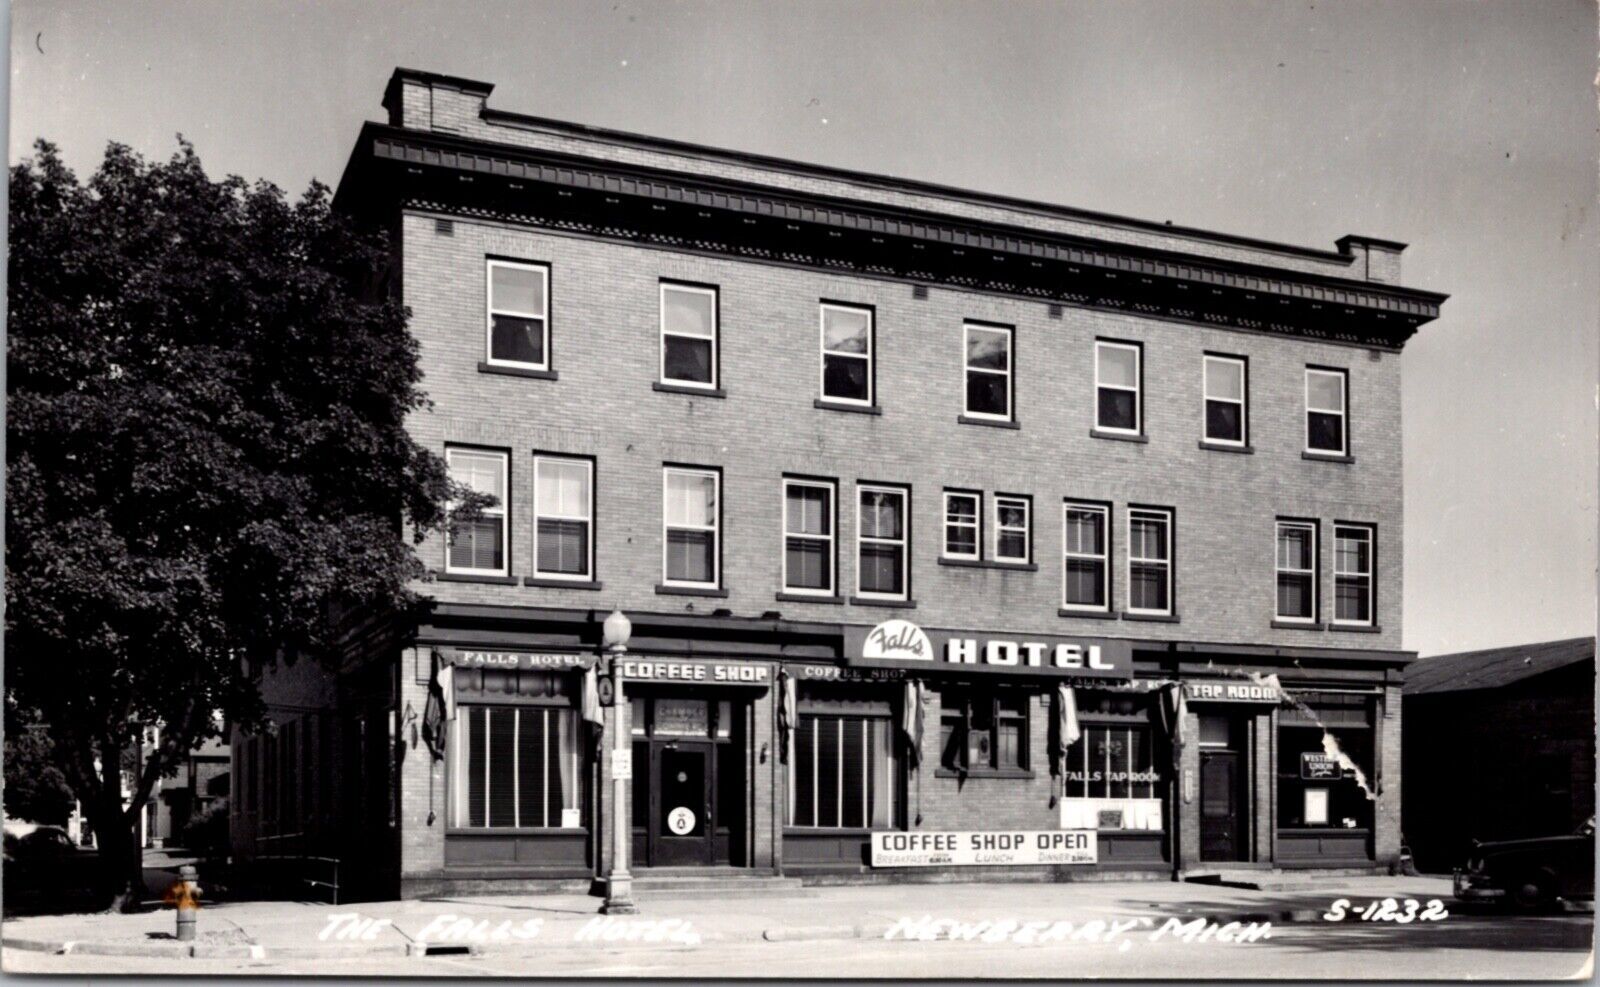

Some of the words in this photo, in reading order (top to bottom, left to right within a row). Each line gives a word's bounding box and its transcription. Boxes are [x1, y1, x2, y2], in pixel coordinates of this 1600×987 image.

[869, 626, 924, 657] Falls
[947, 638, 1114, 670] HOTEL
[463, 652, 519, 664] FALLS
[529, 654, 585, 665] HOTEL
[624, 662, 706, 680] COFFEE
[714, 665, 768, 681] SHOP
[804, 666, 861, 678] COFFEE
[1193, 685, 1222, 698] TAP
[1227, 686, 1279, 700] ROOM
[1064, 771, 1102, 781] FALLS
[1105, 771, 1127, 781] TAP
[882, 834, 957, 850] COFFEE
[970, 835, 1025, 850] SHOP
[1037, 833, 1088, 849] OPEN
[974, 853, 1014, 863] LUNCH
[1038, 852, 1070, 862] DINNER
